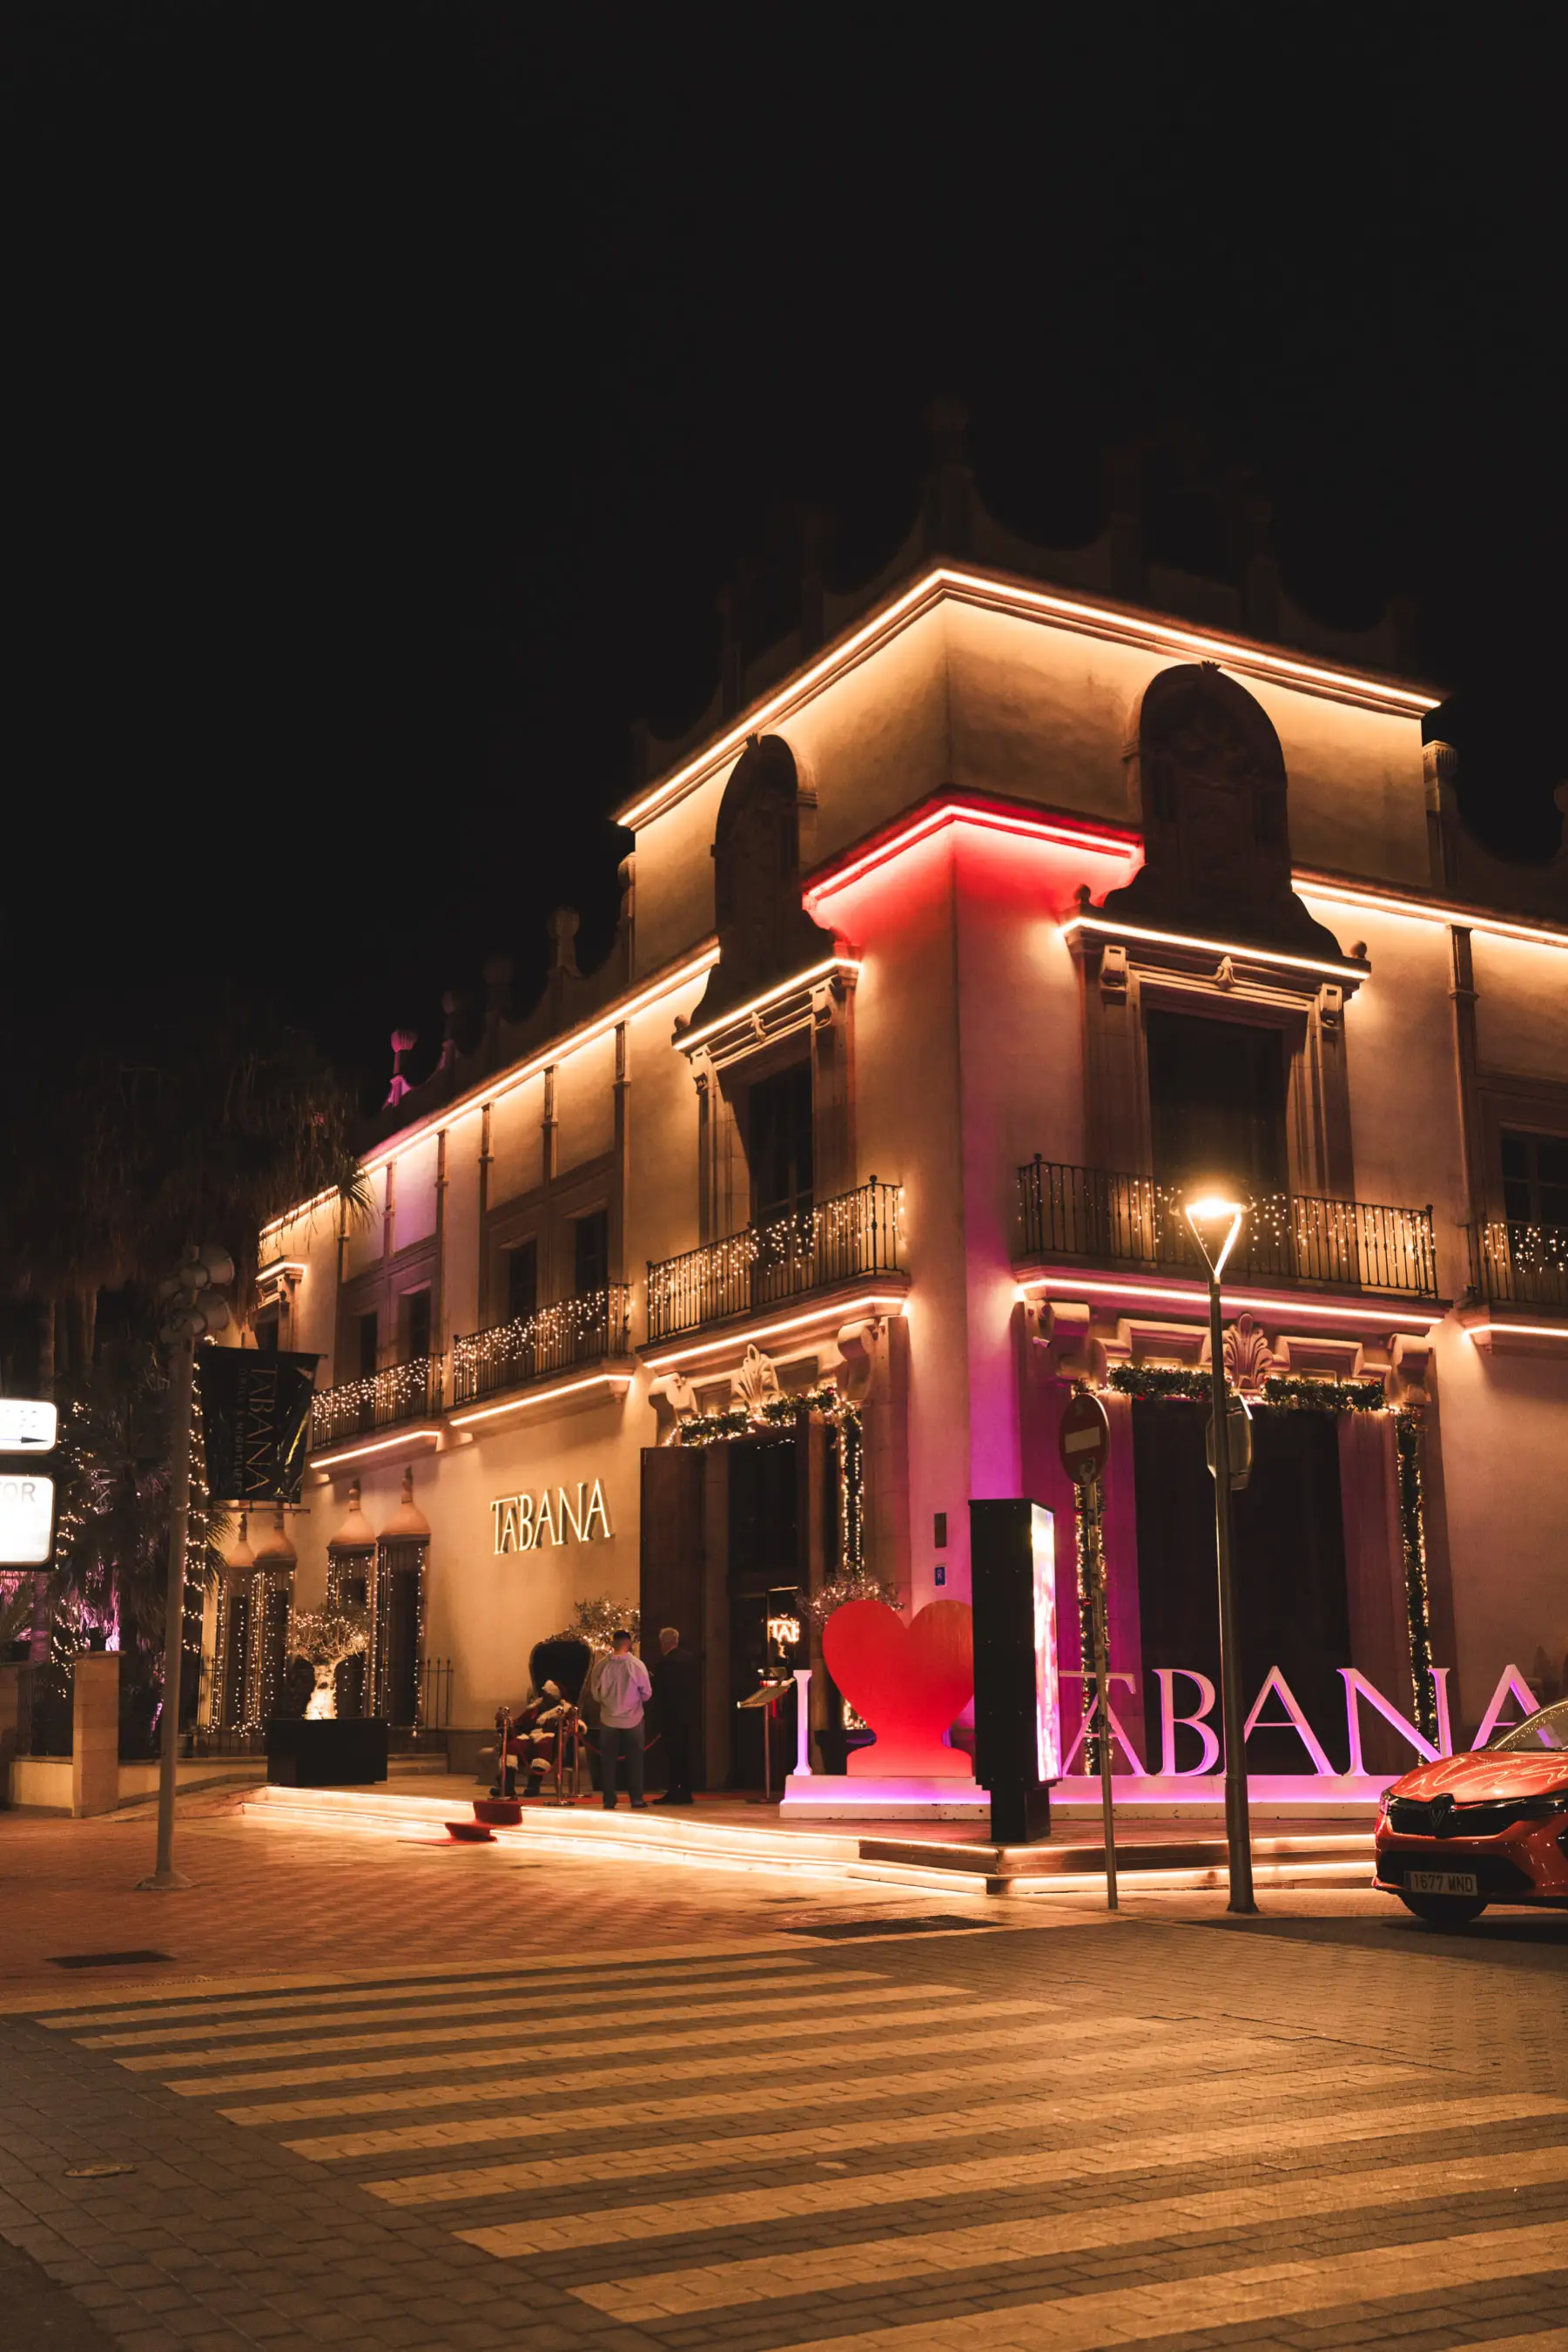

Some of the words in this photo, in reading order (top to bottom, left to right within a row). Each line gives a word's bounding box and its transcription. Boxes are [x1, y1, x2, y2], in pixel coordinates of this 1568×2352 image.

[246, 1363, 278, 1492] TABANA
[490, 1478, 611, 1555] TABANA
[1414, 1874, 1443, 1892] 1677
[1448, 1875, 1473, 1893] MND
